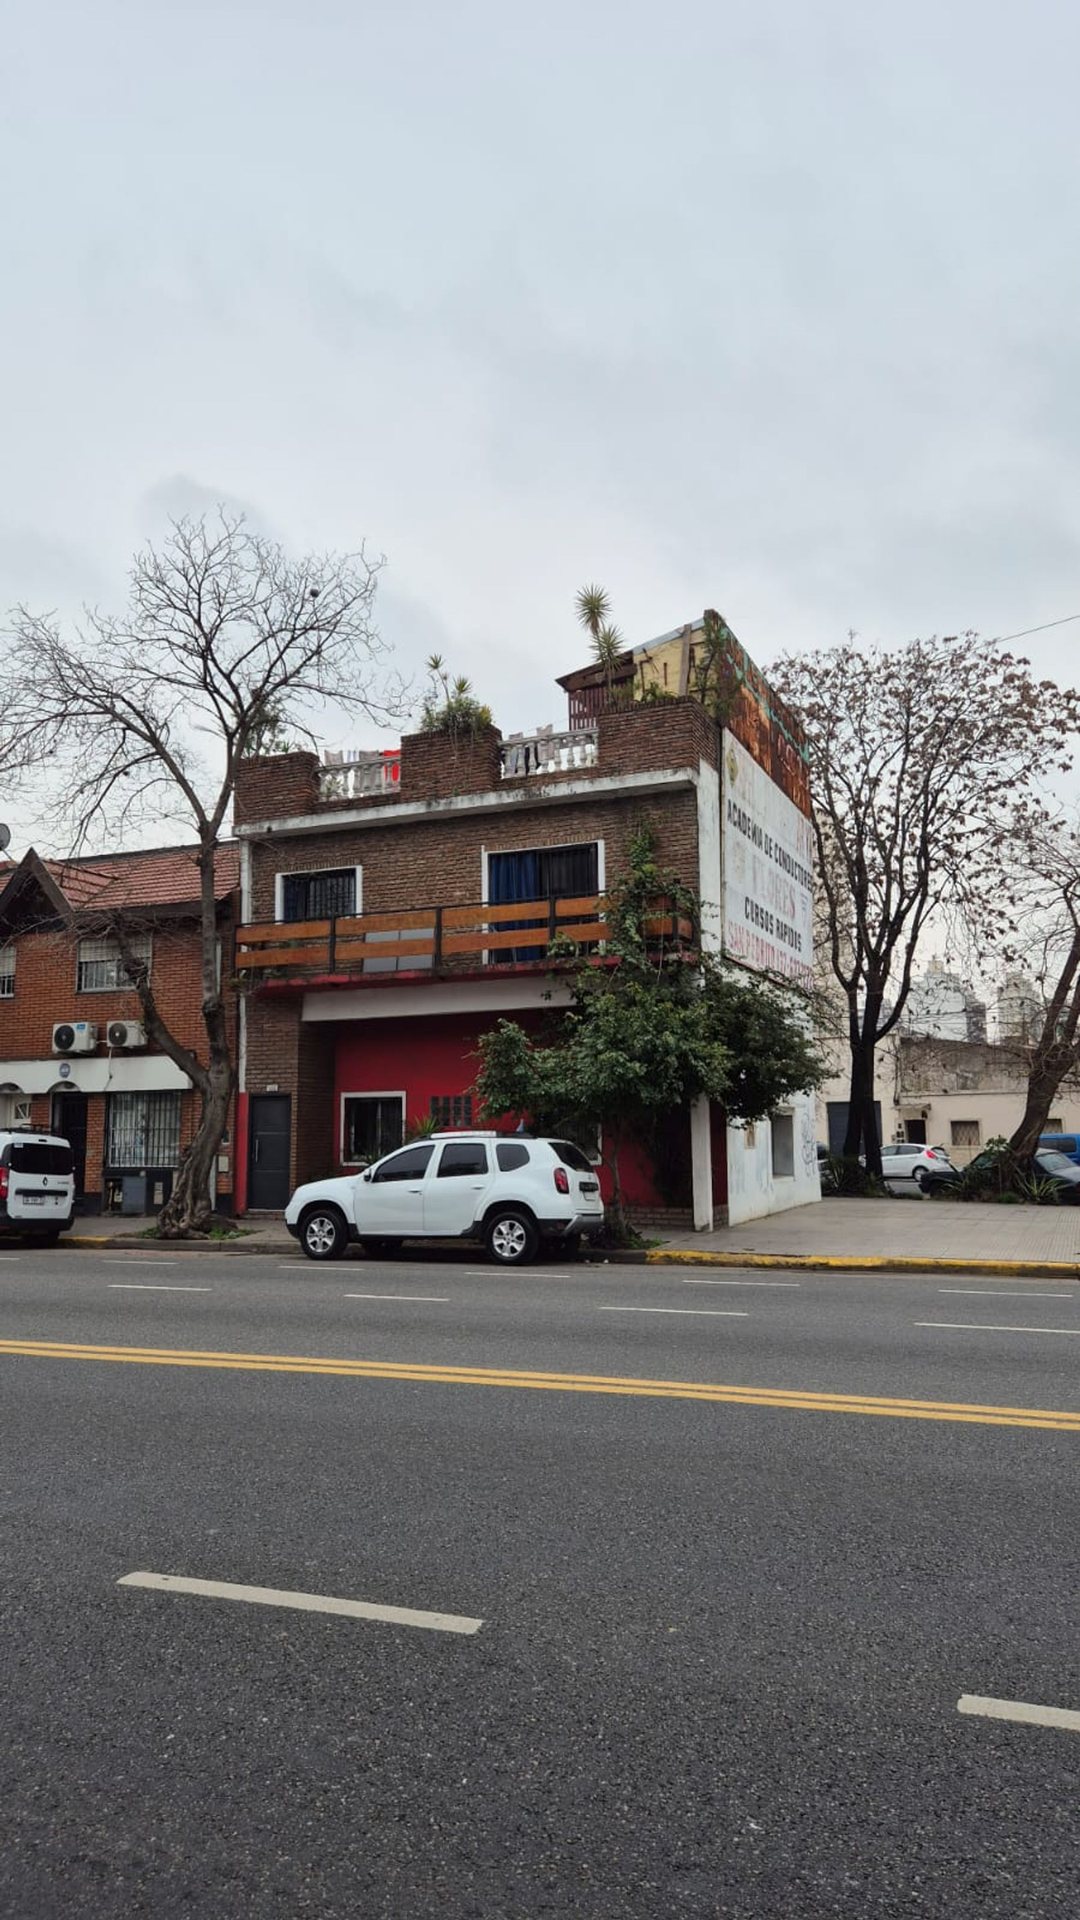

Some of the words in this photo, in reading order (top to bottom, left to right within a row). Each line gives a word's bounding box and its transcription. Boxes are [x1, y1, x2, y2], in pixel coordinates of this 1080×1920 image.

[727, 798, 762, 851] ACADEMIA
[764, 832, 773, 859] DE
[744, 895, 774, 935] CURSOS
[775, 917, 802, 952] RAPIDOS
